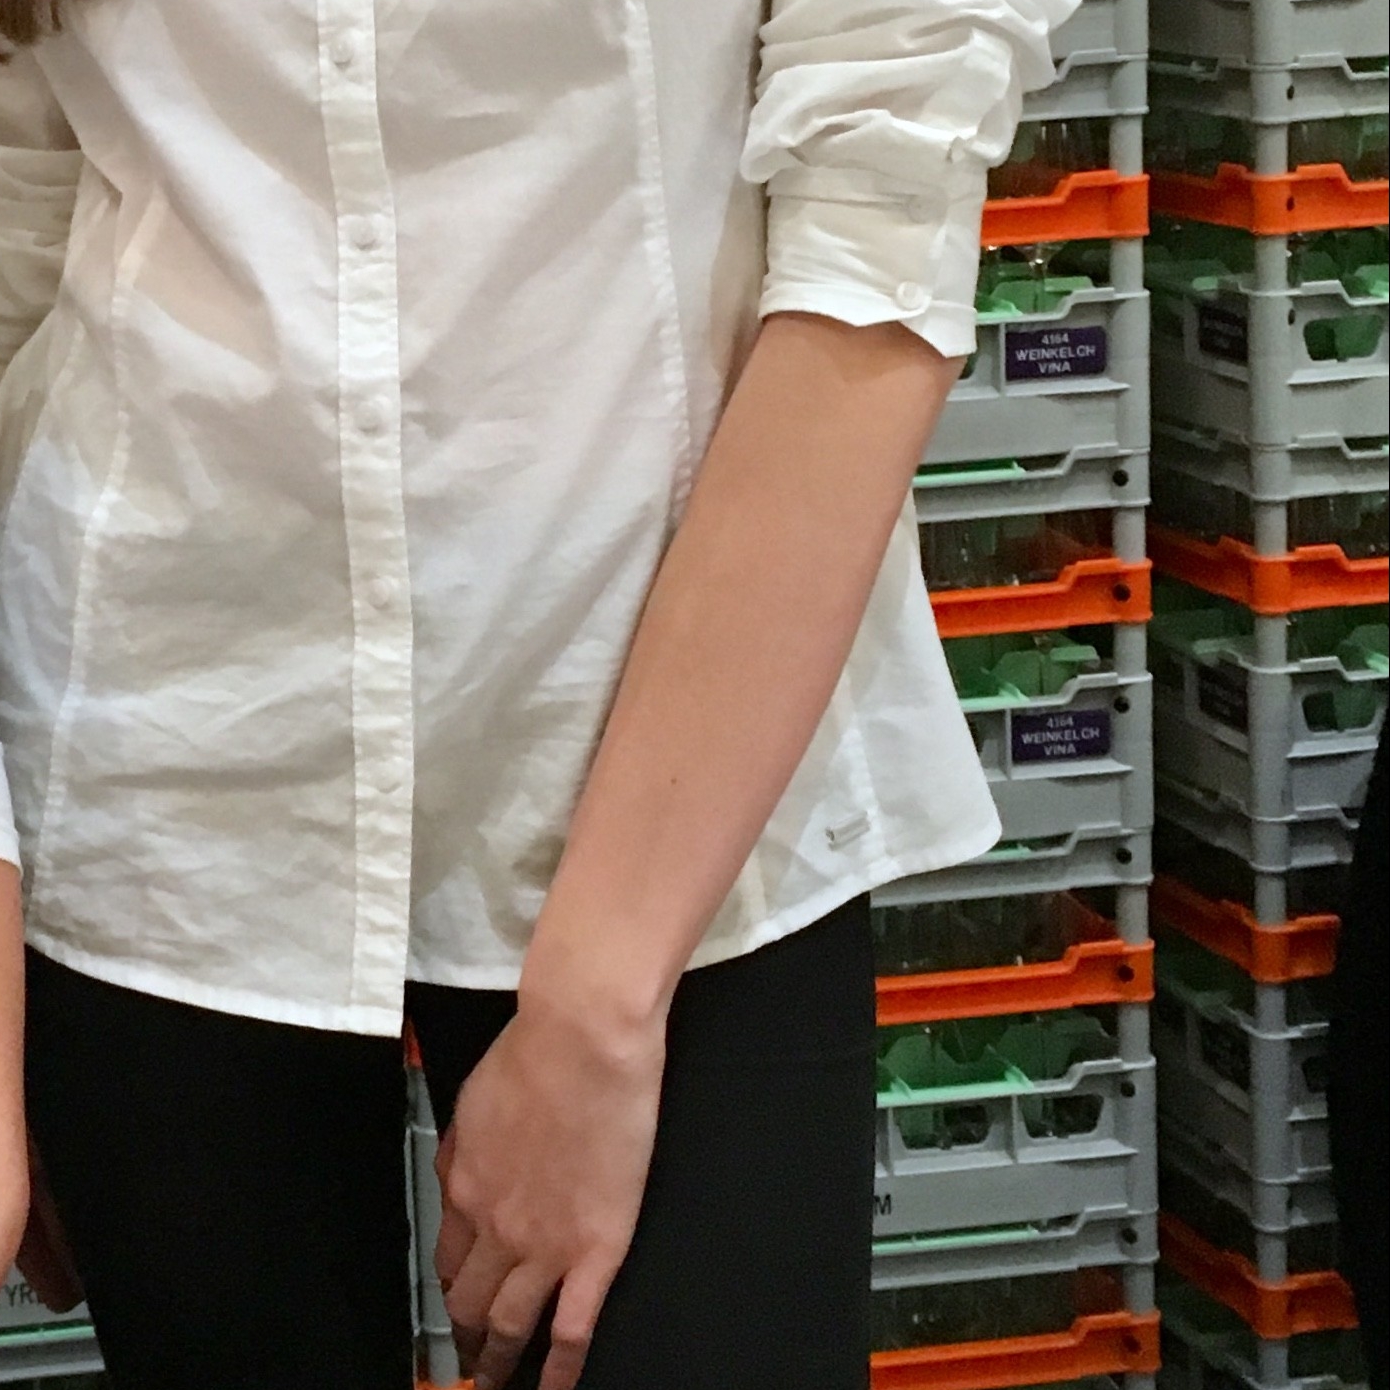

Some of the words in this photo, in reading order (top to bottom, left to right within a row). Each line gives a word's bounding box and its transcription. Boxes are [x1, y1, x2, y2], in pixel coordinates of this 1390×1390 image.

[1015, 345, 1096, 361] WEINKELCH
[1037, 361, 1072, 374] VINA
[1021, 727, 1100, 744] WEINKELCH
[1043, 743, 1077, 756] VINA
